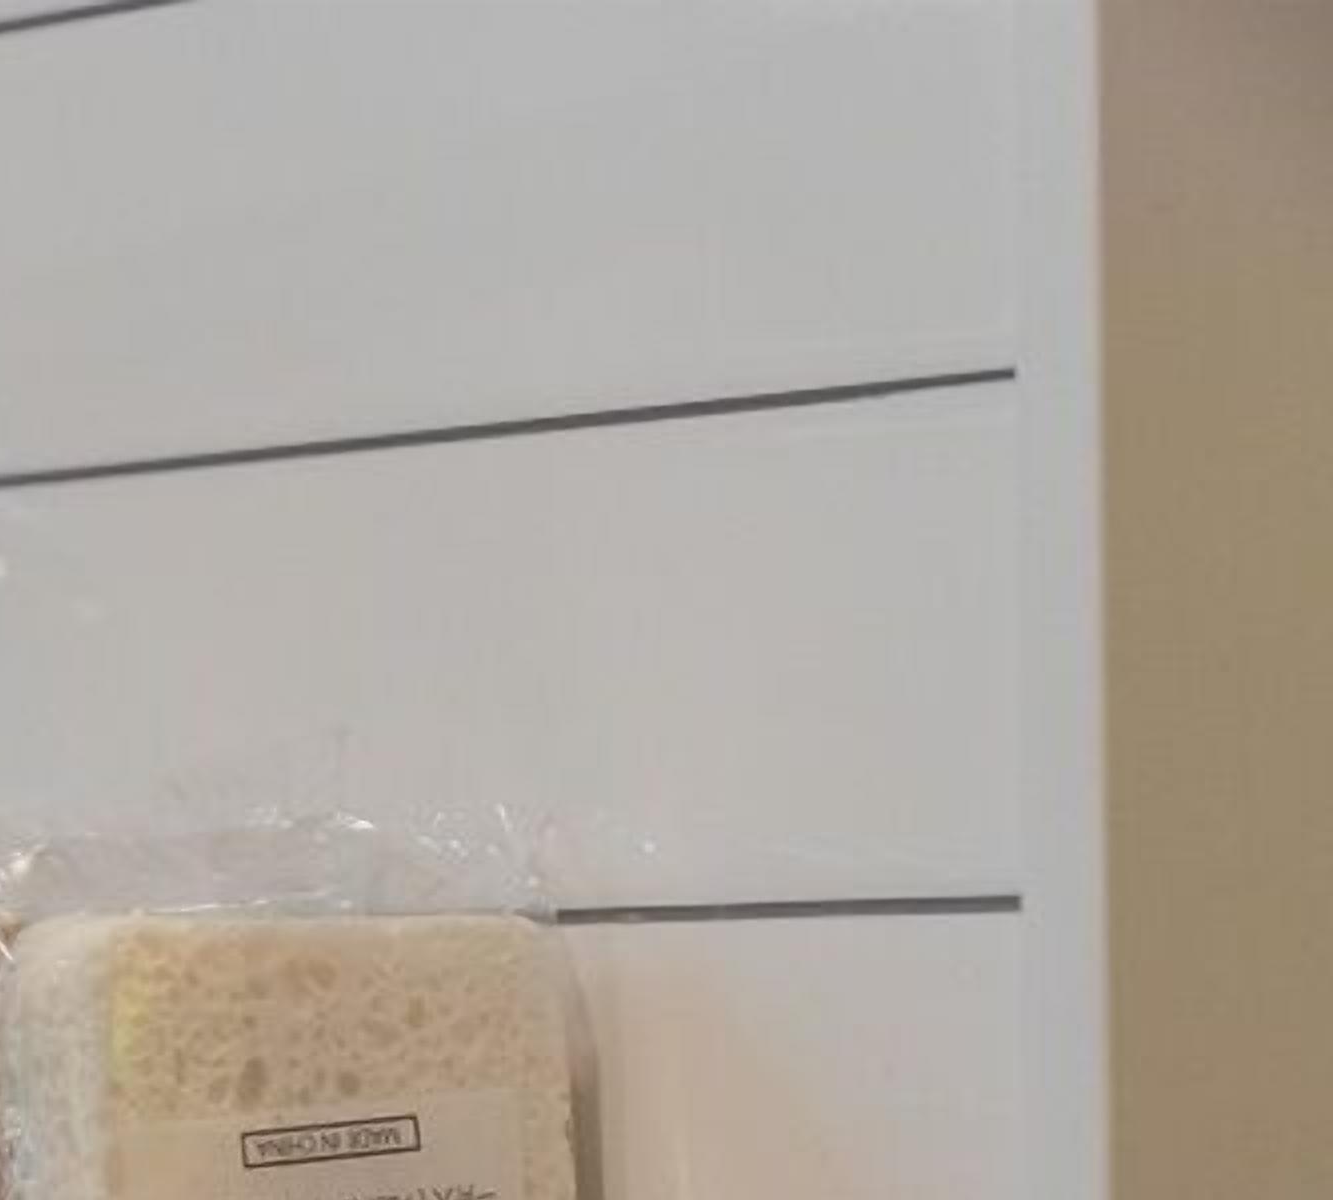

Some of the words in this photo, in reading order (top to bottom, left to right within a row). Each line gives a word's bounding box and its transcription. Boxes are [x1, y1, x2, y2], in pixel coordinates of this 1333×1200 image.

[255, 1134, 317, 1158] CHINA
[320, 1133, 342, 1151] IN
[348, 1128, 403, 1147] MADE
